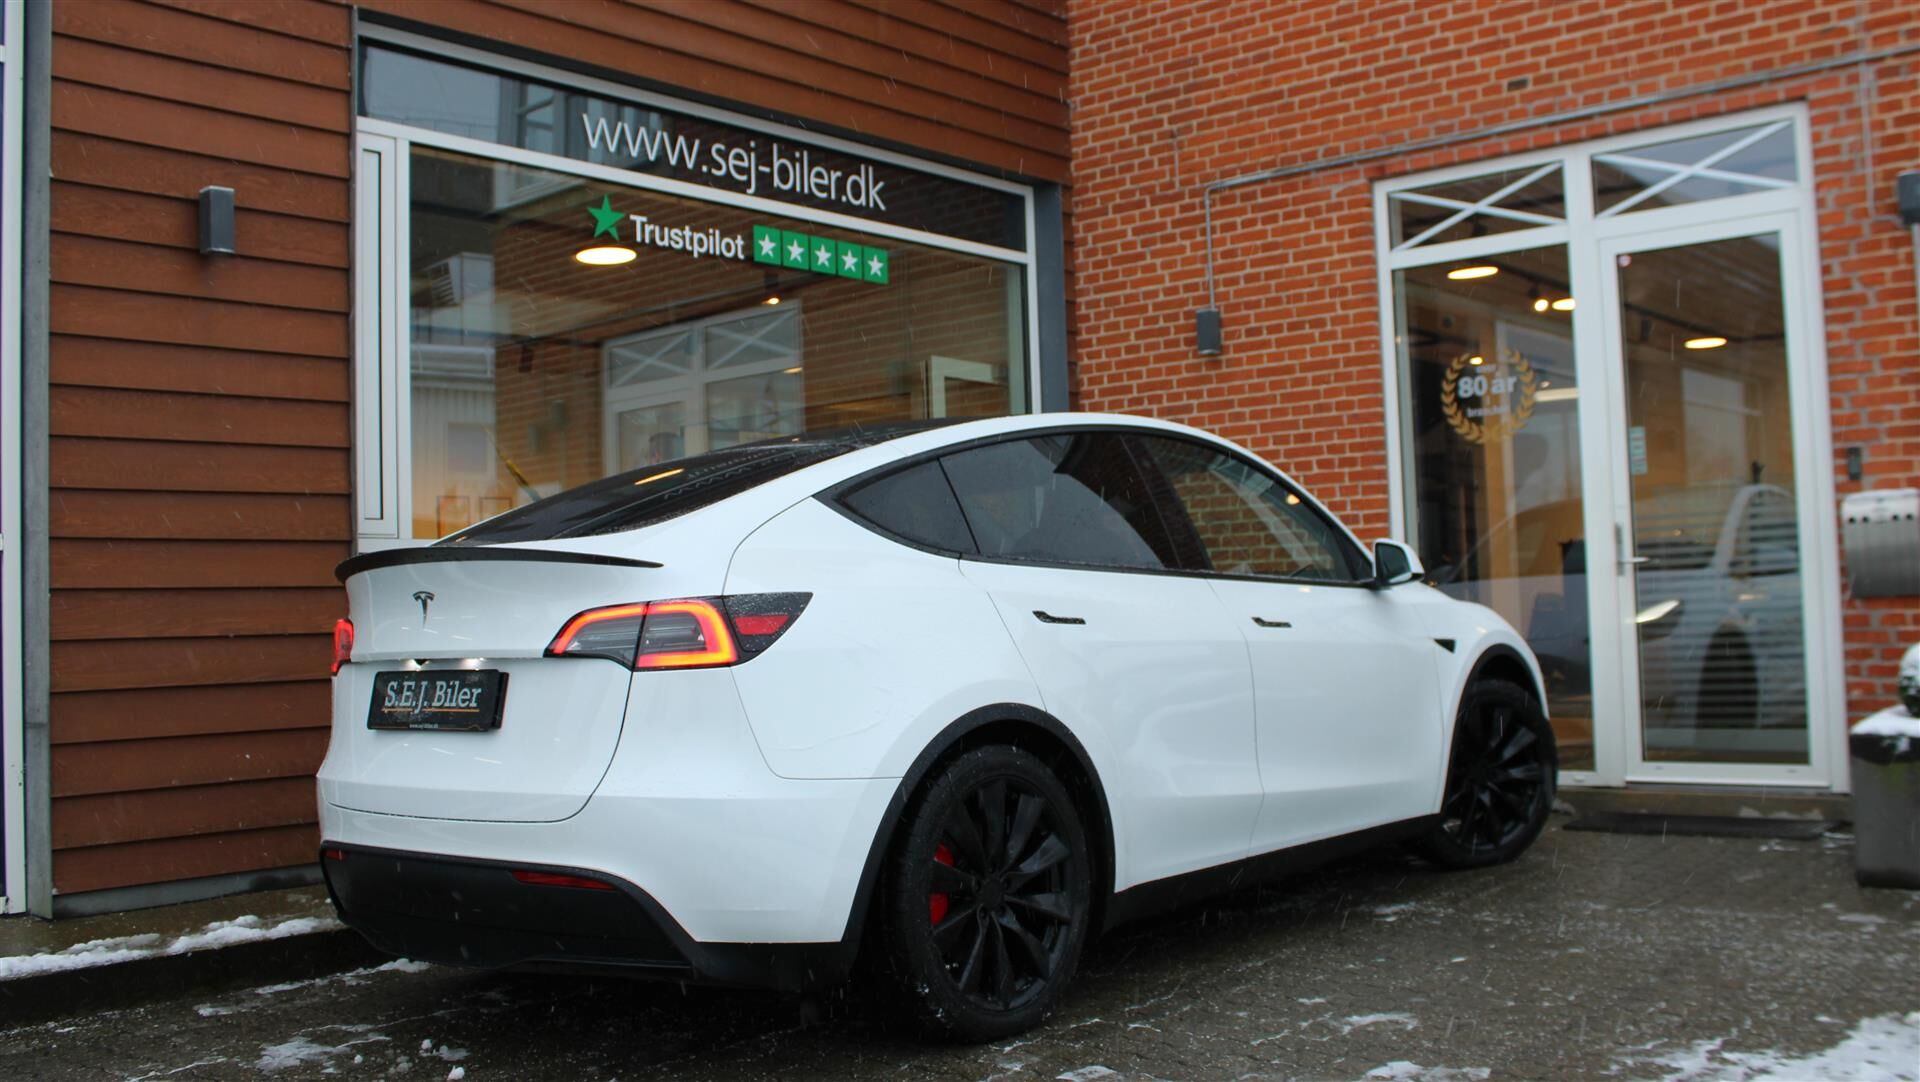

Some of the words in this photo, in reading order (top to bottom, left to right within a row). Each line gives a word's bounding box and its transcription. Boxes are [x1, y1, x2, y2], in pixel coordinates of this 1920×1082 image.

[583, 113, 886, 210] www.sej-biler.dk
[630, 214, 745, 260] Trustpilot
[1458, 375, 1488, 398] 80
[384, 680, 429, 713] S.E.J.
[431, 680, 482, 707] Biler
